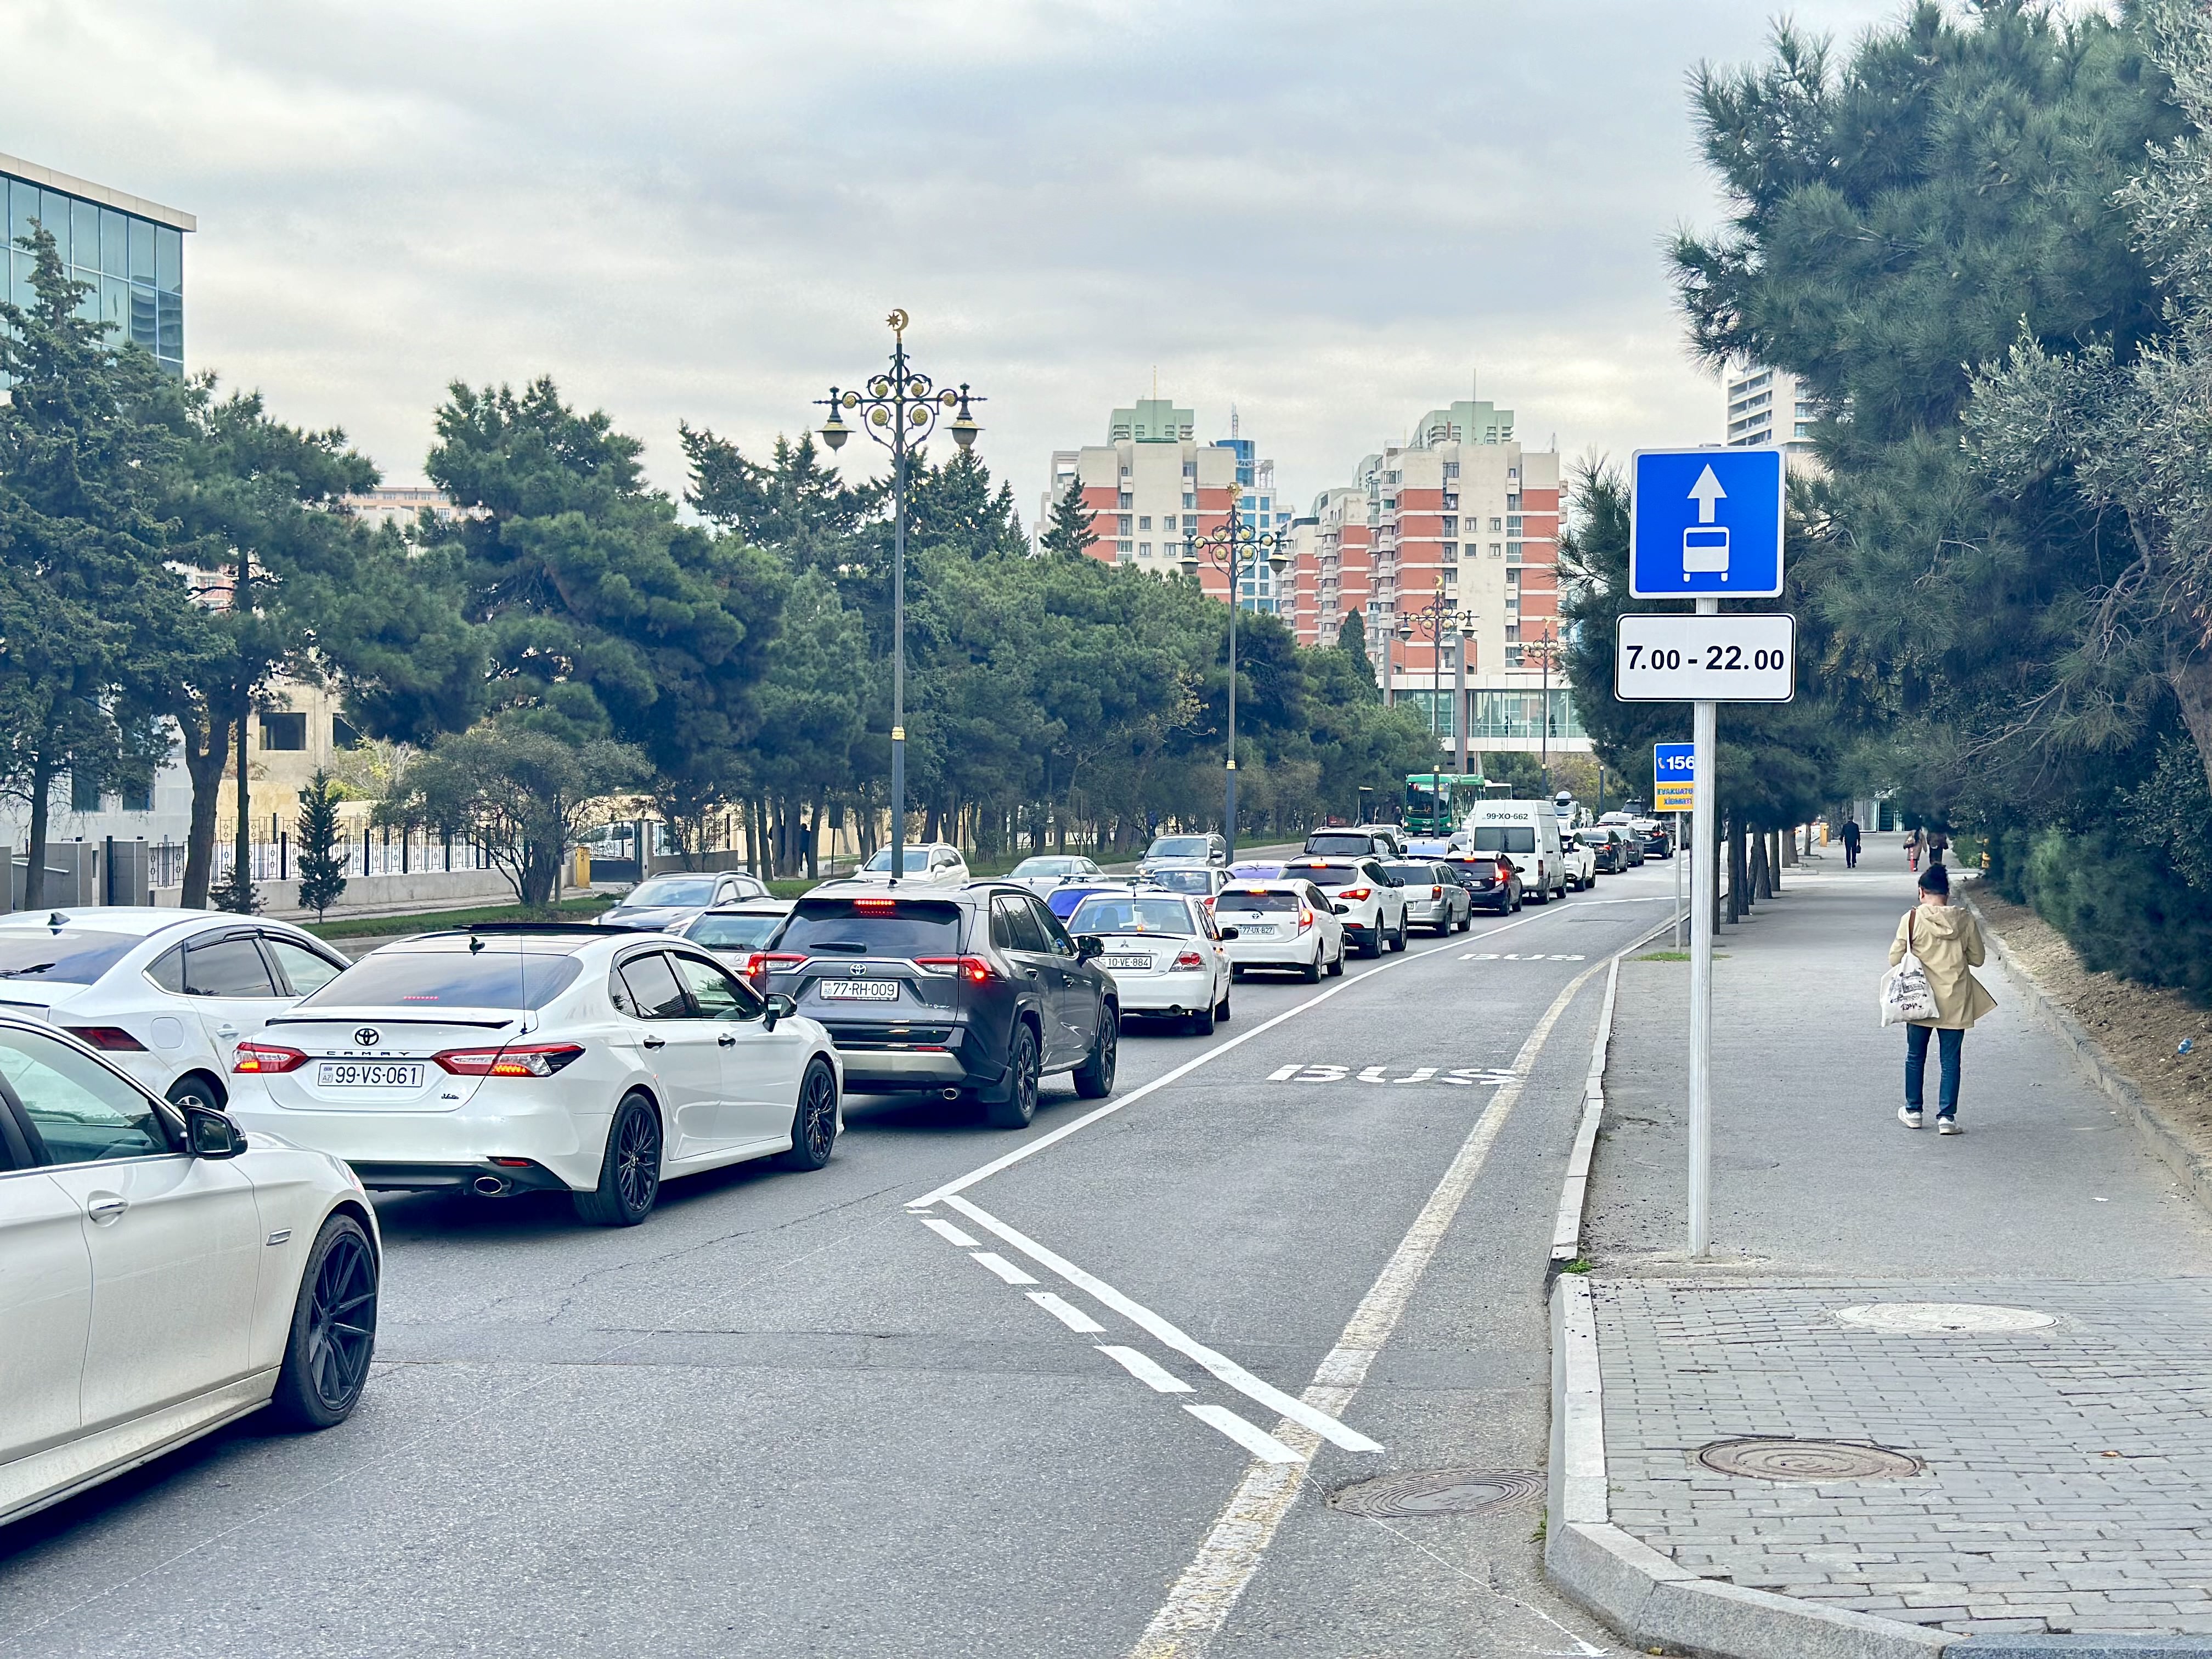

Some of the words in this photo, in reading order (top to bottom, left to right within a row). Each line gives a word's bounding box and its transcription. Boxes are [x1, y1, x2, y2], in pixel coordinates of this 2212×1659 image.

[1626, 645, 1680, 670] 7.00
[1705, 645, 1785, 670] 22.00
[1666, 755, 1695, 770] 156
[1108, 958, 1148, 967] 10-VE-884
[833, 982, 895, 996] 77-RH-009
[335, 1066, 417, 1085] 99-VS-061
[1265, 1064, 1518, 1085] BUS
